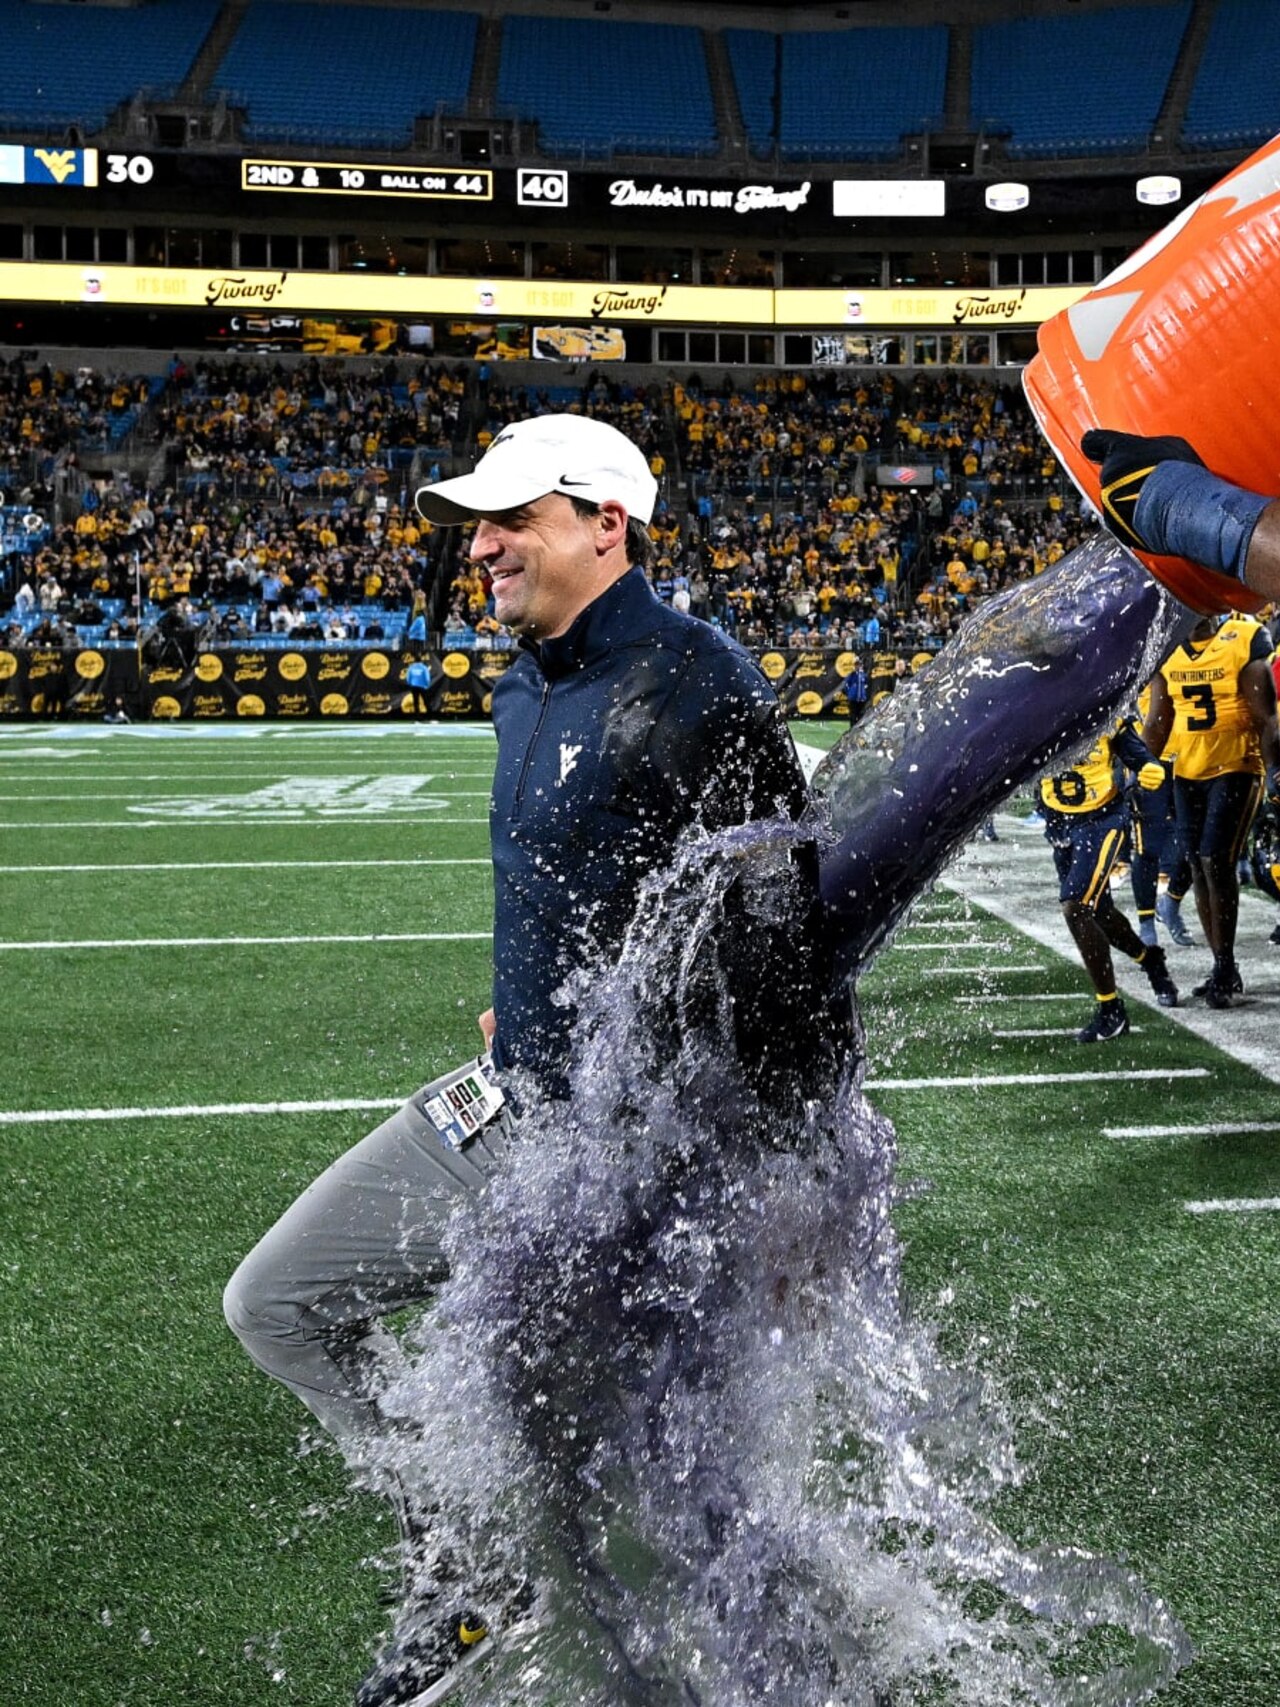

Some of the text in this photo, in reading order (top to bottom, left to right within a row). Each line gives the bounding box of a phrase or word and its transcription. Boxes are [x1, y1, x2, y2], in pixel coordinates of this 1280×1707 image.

[106, 155, 154, 184] 30
[247, 165, 483, 194] 2ND & 10 BALL ON 44
[523, 176, 564, 199] 40
[205, 271, 287, 306] Twang!
[591, 285, 667, 318] Twang!
[952, 288, 1027, 325] Twang!
[1182, 683, 1217, 732] 3
